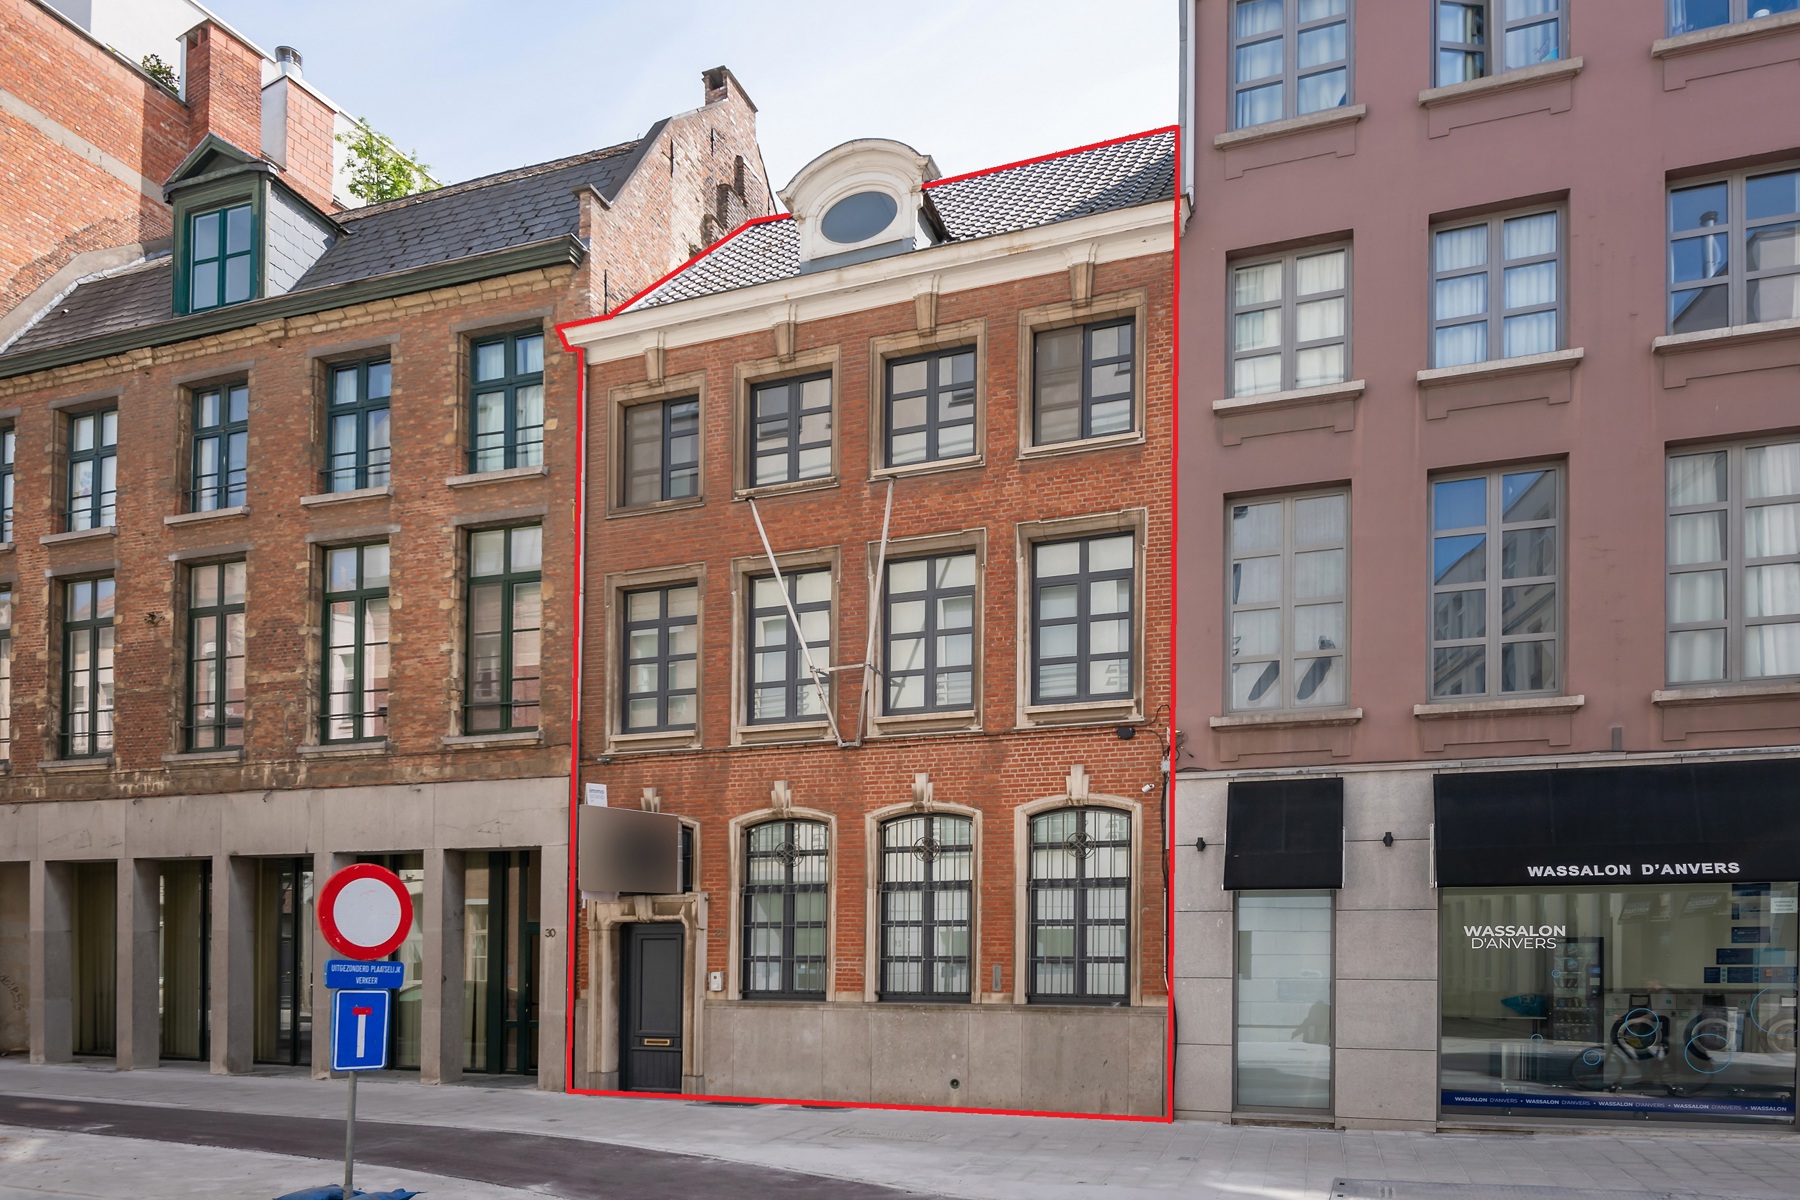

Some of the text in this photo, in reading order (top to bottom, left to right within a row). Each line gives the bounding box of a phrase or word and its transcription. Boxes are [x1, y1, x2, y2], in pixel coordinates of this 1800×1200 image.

[1527, 862, 1741, 877] WASSALON D'ANVERS
[544, 928, 556, 938] 30
[1463, 925, 1566, 937] WASSALON
[1471, 937, 1557, 949] D'ANVERS
[331, 964, 402, 973] UITGEZONDERD PLAATSELIJK
[355, 976, 378, 984] VERKEER
